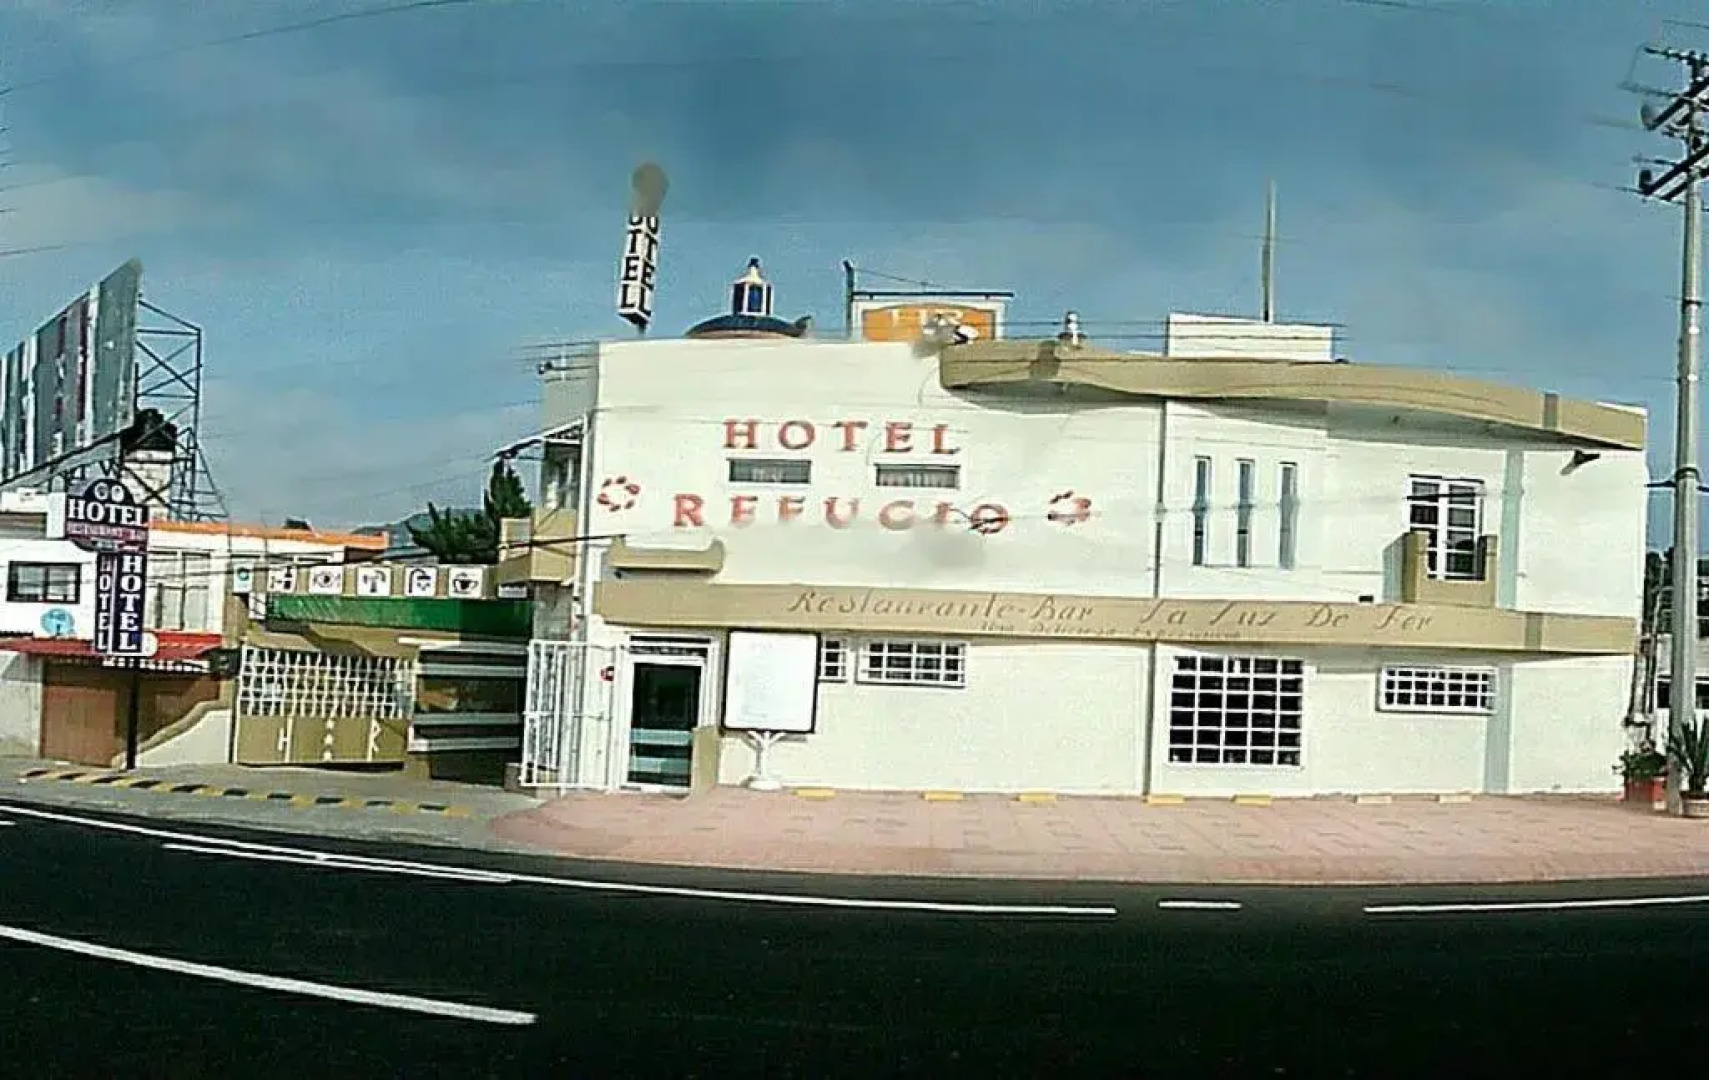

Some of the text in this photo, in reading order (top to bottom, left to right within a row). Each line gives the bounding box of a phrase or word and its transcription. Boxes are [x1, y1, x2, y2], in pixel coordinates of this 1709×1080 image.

[723, 418, 960, 455] HOTEL
[68, 498, 144, 526] HOTEL
[118, 554, 143, 651] HOTEL
[1303, 601, 1349, 628] De
